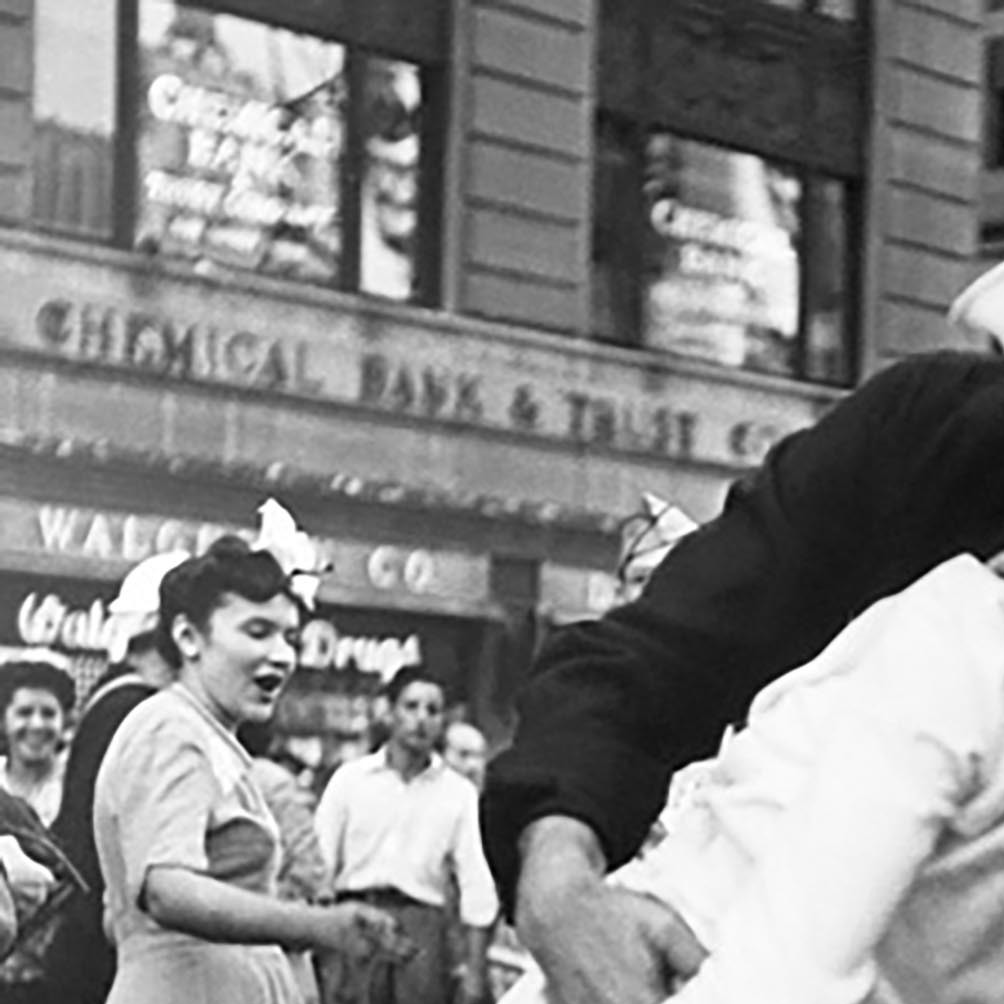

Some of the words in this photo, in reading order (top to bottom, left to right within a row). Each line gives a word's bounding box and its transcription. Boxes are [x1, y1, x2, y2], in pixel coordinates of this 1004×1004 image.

[359, 354, 484, 418] BANK
[509, 383, 540, 429] &
[563, 391, 698, 462] TRUST
[300, 618, 422, 683] Drugs
